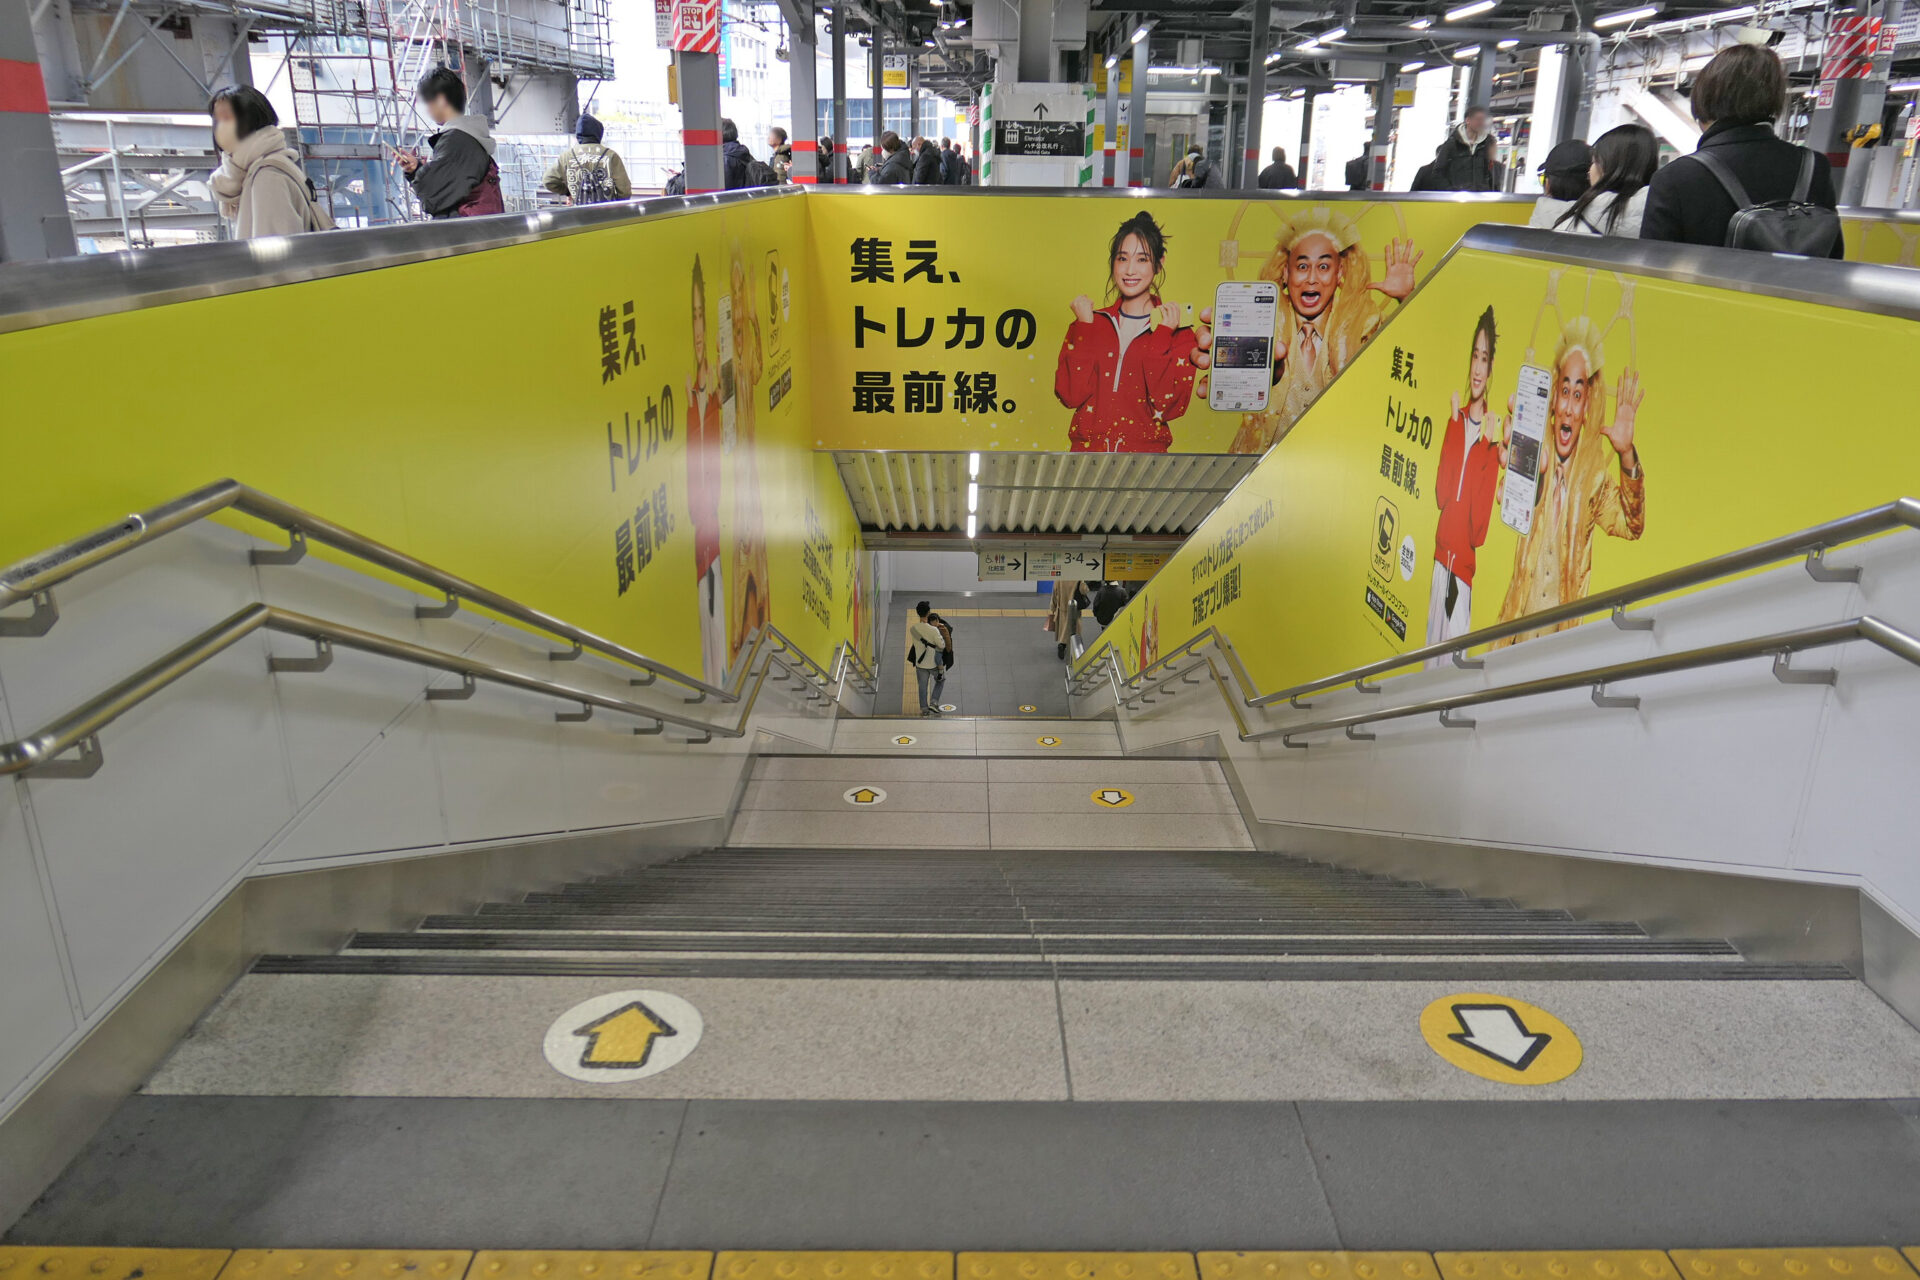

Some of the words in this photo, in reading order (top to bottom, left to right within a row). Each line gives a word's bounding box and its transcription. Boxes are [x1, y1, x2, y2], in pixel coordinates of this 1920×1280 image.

[682, 7, 703, 15] STOP
[1024, 125, 1074, 135] エレベーター
[850, 237, 961, 283] 集え、
[599, 300, 646, 386] 集え、
[855, 305, 1037, 350] トレカの
[1390, 346, 1417, 389] 集え、
[852, 371, 1017, 414] 最前線。
[607, 384, 674, 493] トレカの
[1386, 395, 1432, 450] トレカの
[1380, 443, 1420, 500] 最前線。
[615, 482, 675, 598] 最前線。
